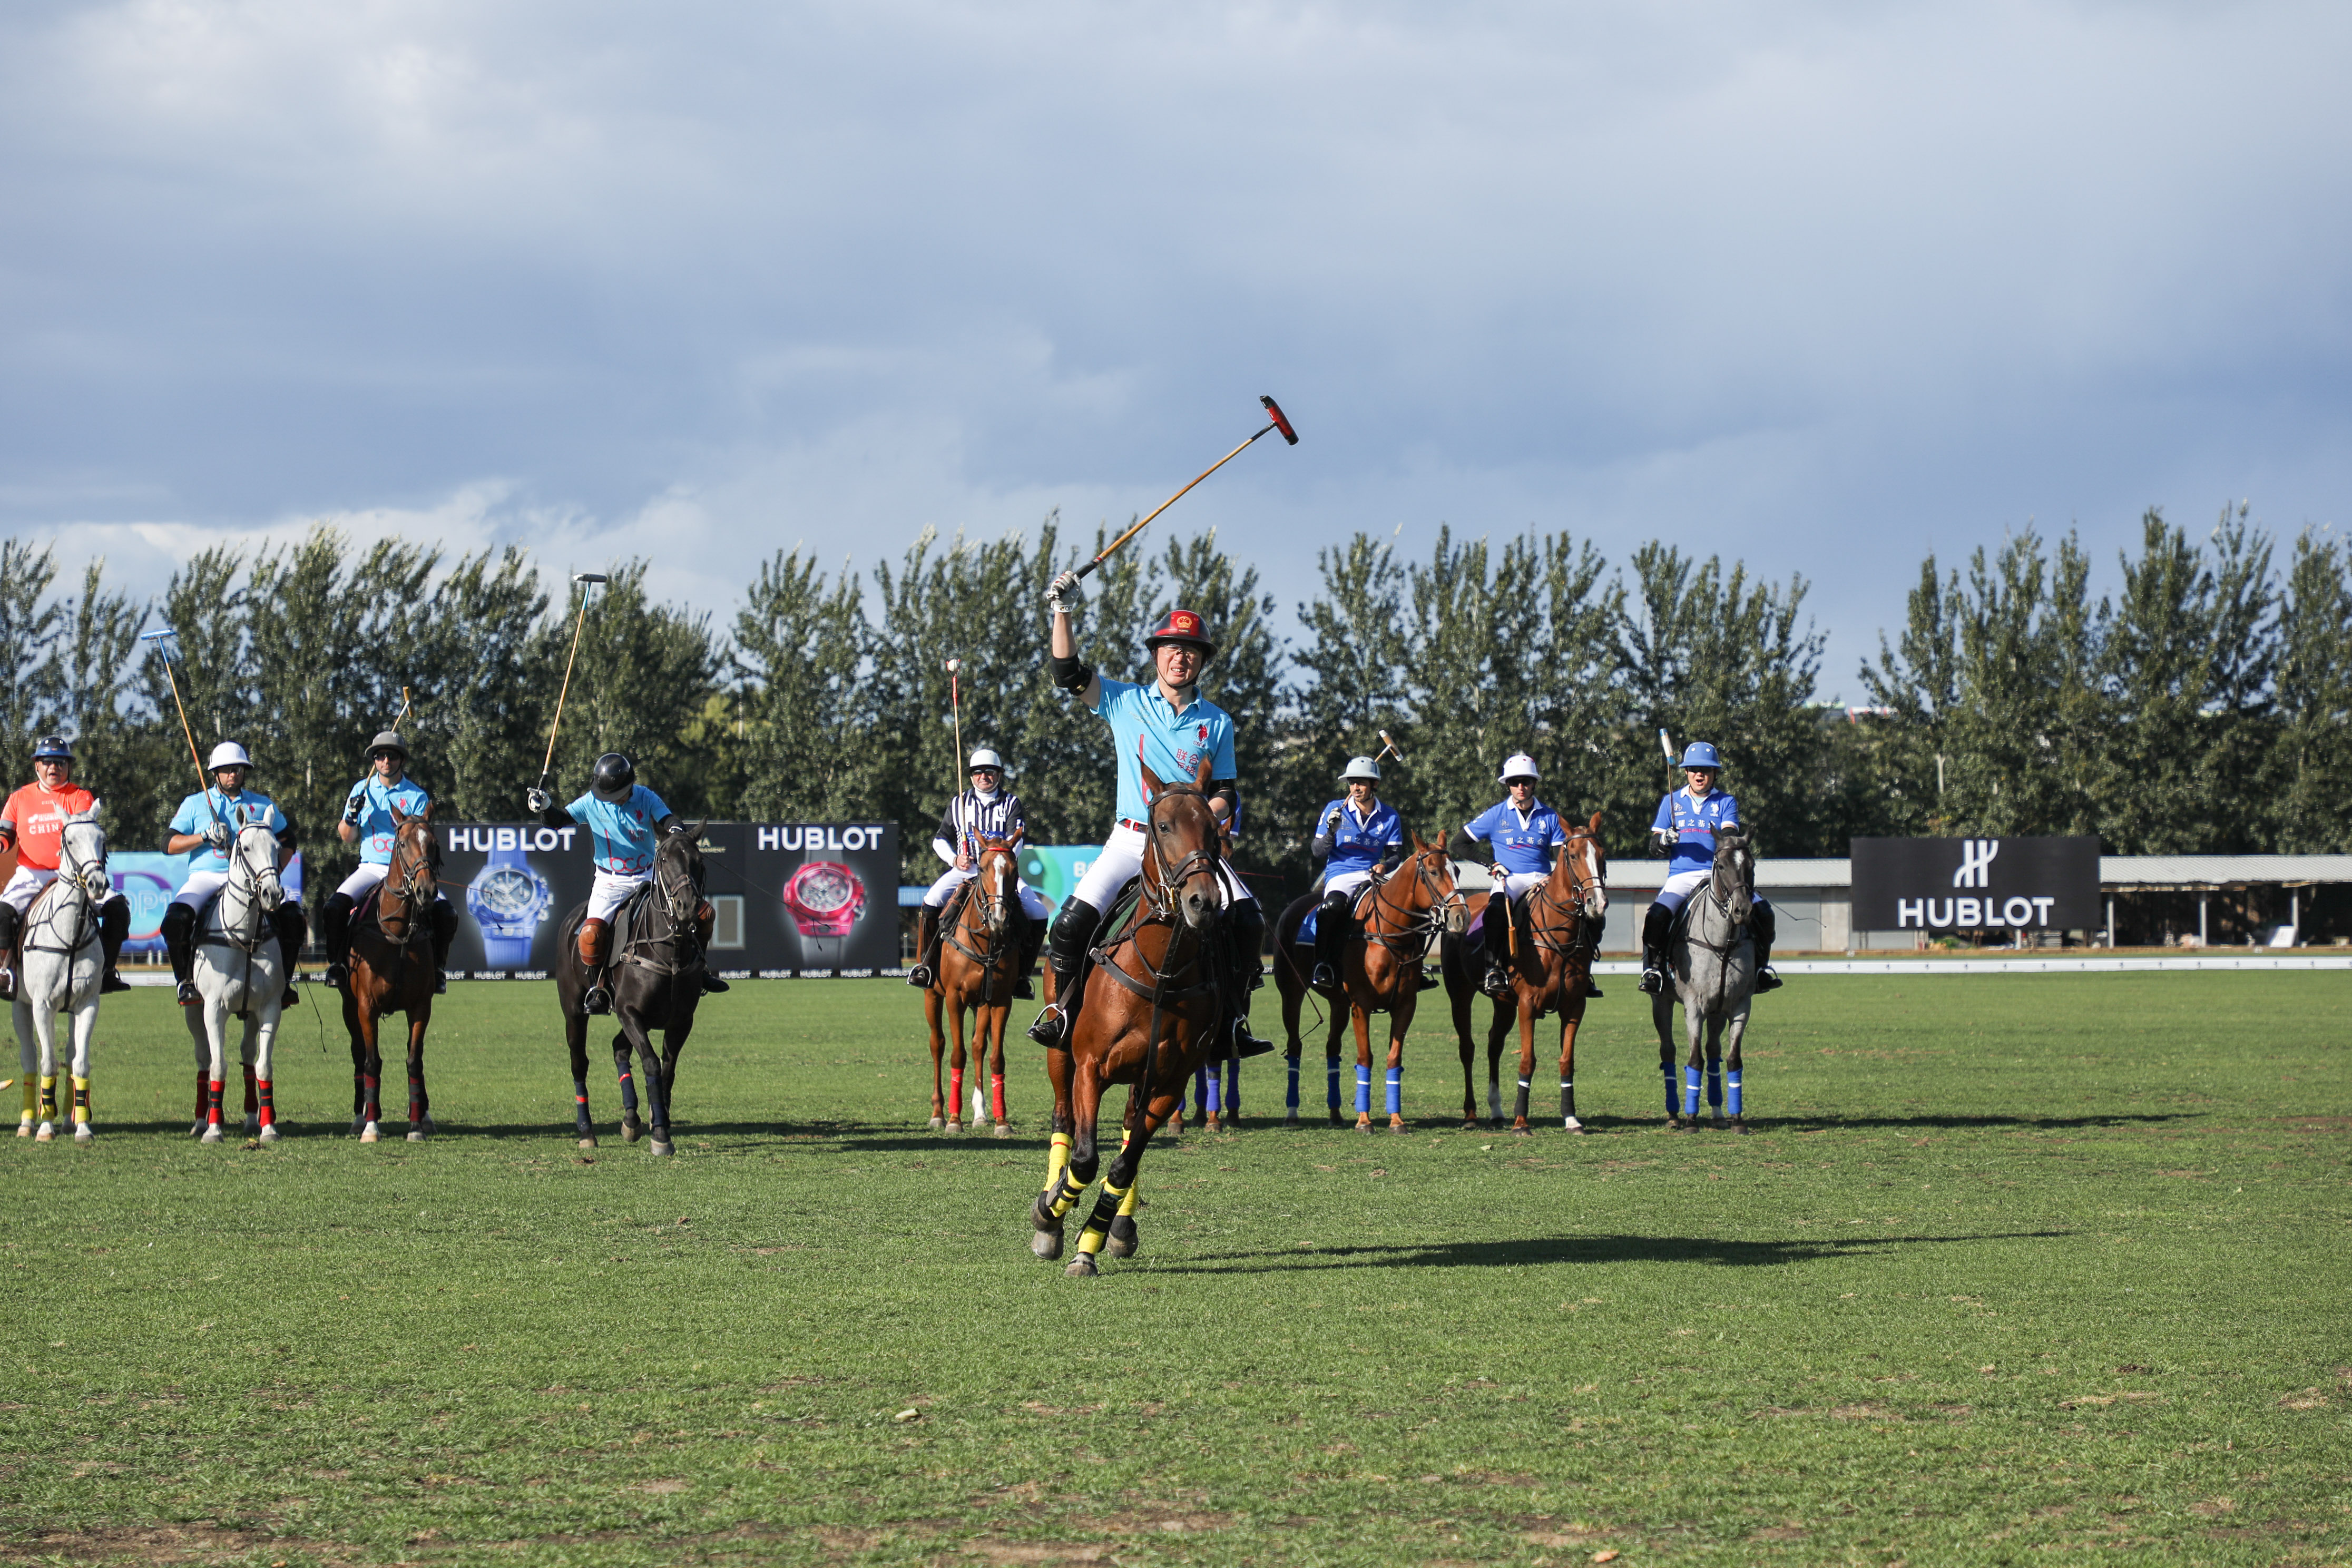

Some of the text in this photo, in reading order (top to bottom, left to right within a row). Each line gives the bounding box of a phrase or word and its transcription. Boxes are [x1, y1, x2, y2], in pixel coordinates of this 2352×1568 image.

[1176, 748, 1199, 765] 联合
[29, 822, 59, 835] CHIN
[449, 827, 577, 852] HUBLOT
[758, 826, 884, 851] HUBLOT
[1898, 896, 2055, 927] HUBLOT
[446, 971, 465, 979] BLOT
[474, 971, 506, 979] HUBLOT
[515, 971, 547, 979] HUBLOT
[719, 970, 751, 979] HUBLOT
[759, 969, 792, 978] HUBLOT
[800, 968, 832, 978] HUBLOT
[840, 968, 873, 977] HUBLOT
